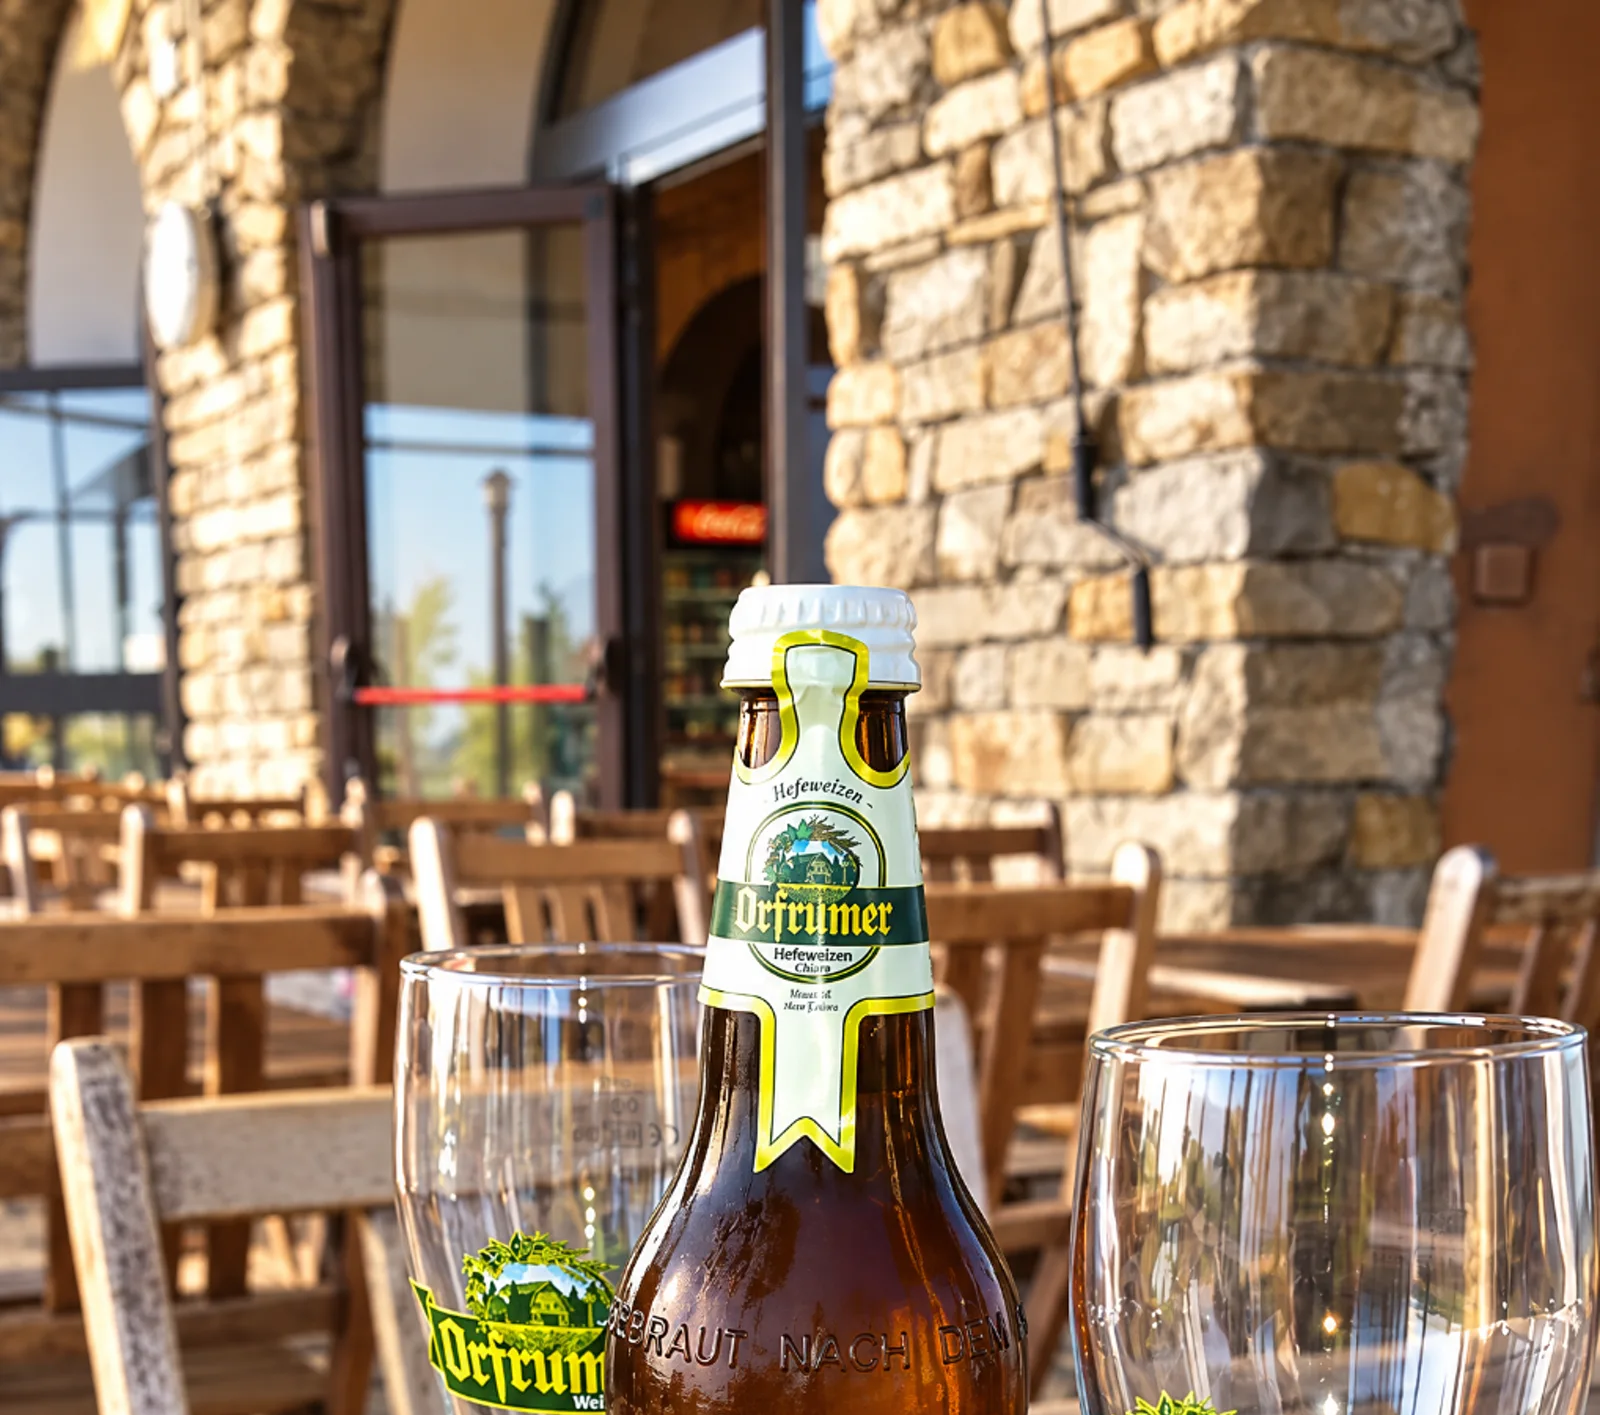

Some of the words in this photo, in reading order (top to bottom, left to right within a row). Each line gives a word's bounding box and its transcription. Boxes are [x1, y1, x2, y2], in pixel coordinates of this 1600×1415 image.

[773, 778, 862, 804] Hefeweizen
[734, 885, 893, 943] Orfrumer
[774, 947, 853, 962] Hefeweizen
[795, 962, 831, 973] Chiara
[780, 1330, 911, 1374] NACH
